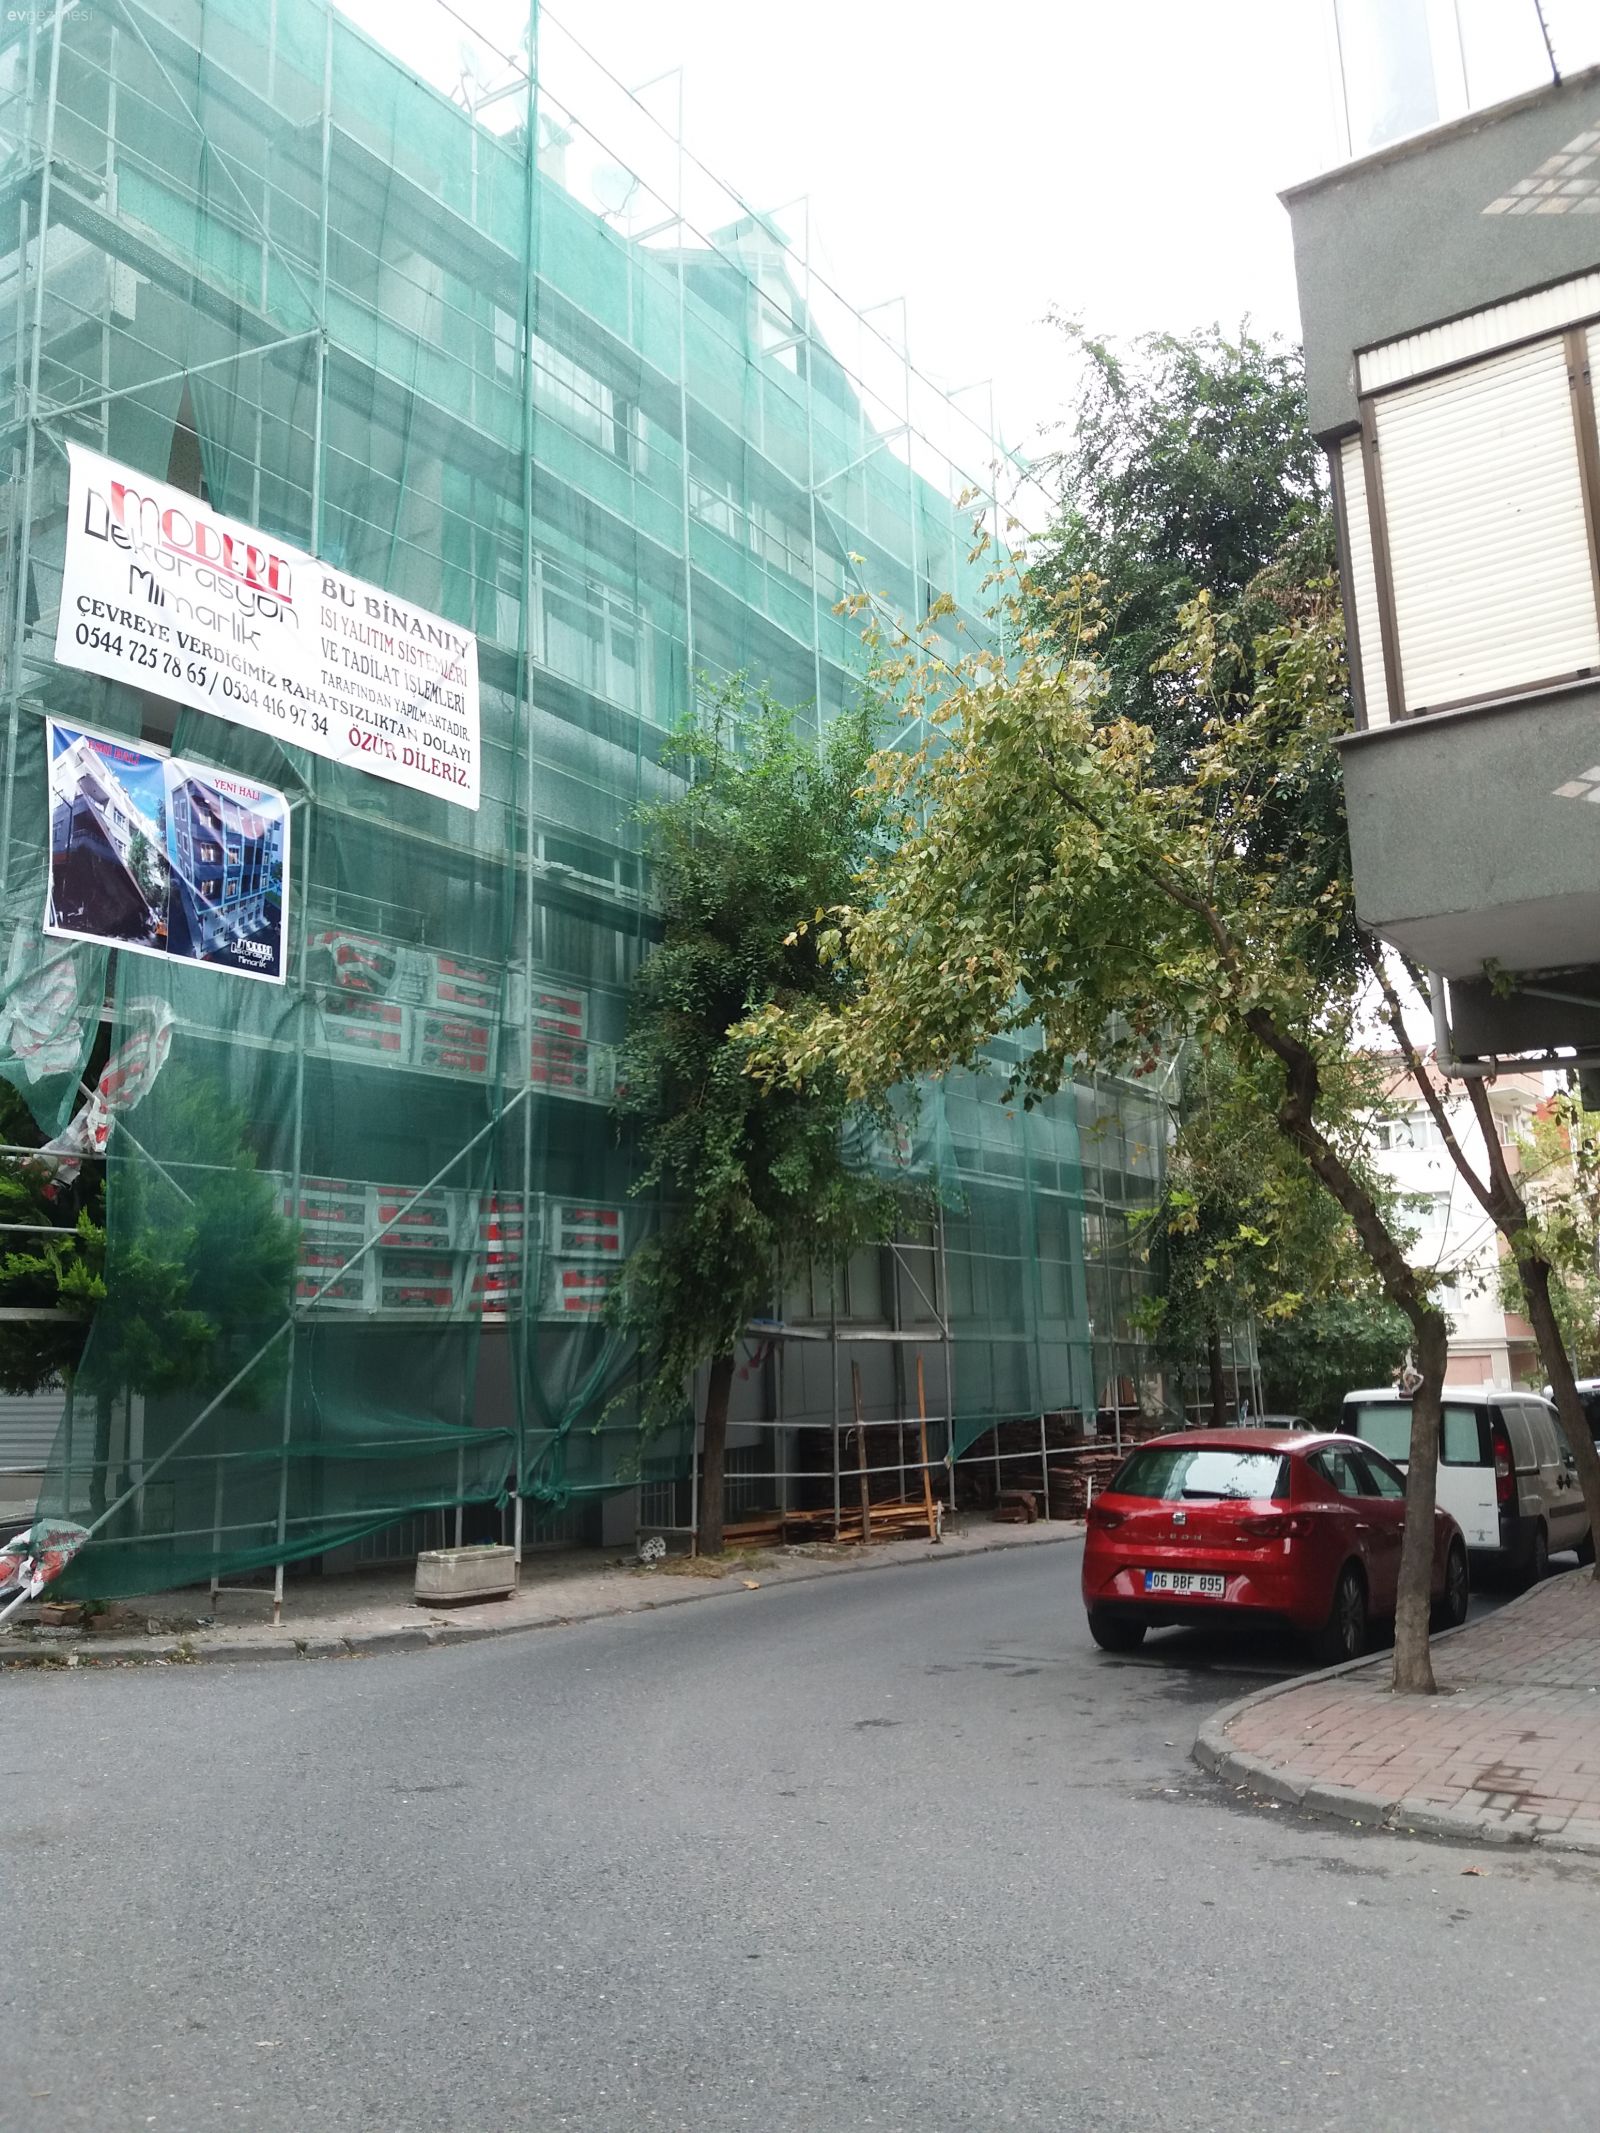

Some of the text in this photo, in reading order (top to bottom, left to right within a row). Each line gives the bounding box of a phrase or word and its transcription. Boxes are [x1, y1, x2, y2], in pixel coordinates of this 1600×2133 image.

[320, 606, 468, 687] ISI YALITIM SİSTEMLERİ
[321, 576, 469, 658] BU BİNANIN
[75, 622, 329, 735] 0544 725 78 65 / 0534 416 97 34
[76, 595, 471, 764] ÇEVREYE VERDİĞİMİZ RAHATSIZLIKTAN DOLAYI
[320, 669, 471, 741] TARAFINDAN YAPILMAKTADIR.
[321, 636, 466, 715] VE TADİLAT İŞLEMLERİ
[214, 778, 237, 795] YENİ
[348, 723, 471, 789] ÖZÜR DİLERİZ.
[1153, 1574, 1222, 1592] 06 BBF 895
